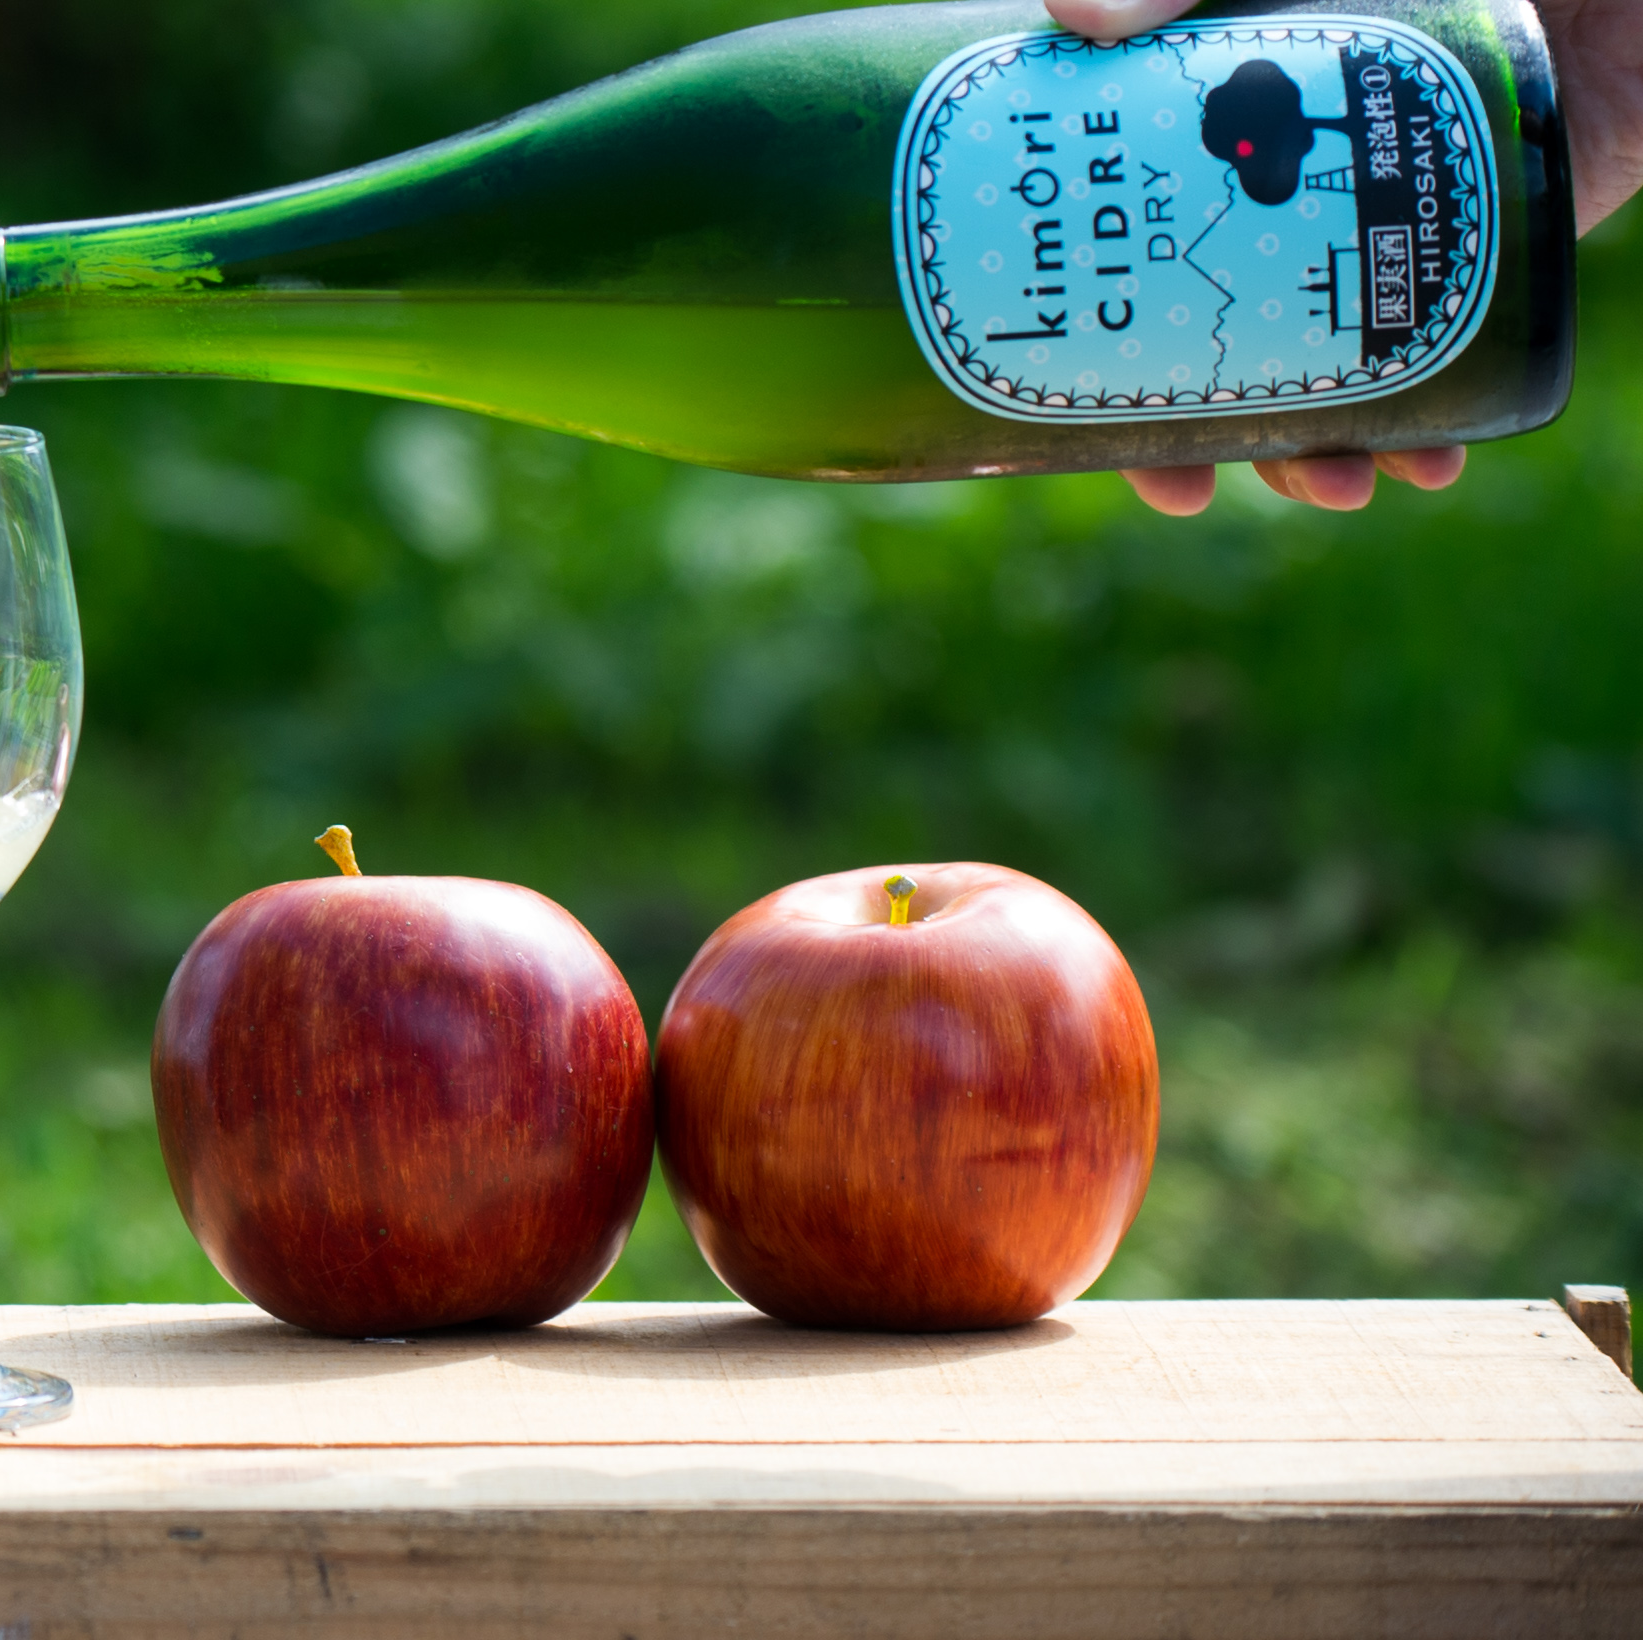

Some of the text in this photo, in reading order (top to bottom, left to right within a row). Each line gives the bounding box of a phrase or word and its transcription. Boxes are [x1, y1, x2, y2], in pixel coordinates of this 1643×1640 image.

[987, 112, 1068, 342] kimori
[1084, 111, 1133, 331] CIDRE
[1142, 162, 1176, 261] DRY
[1376, 233, 1409, 321] 果実酒
[1409, 115, 1442, 283] HIROSAKI
